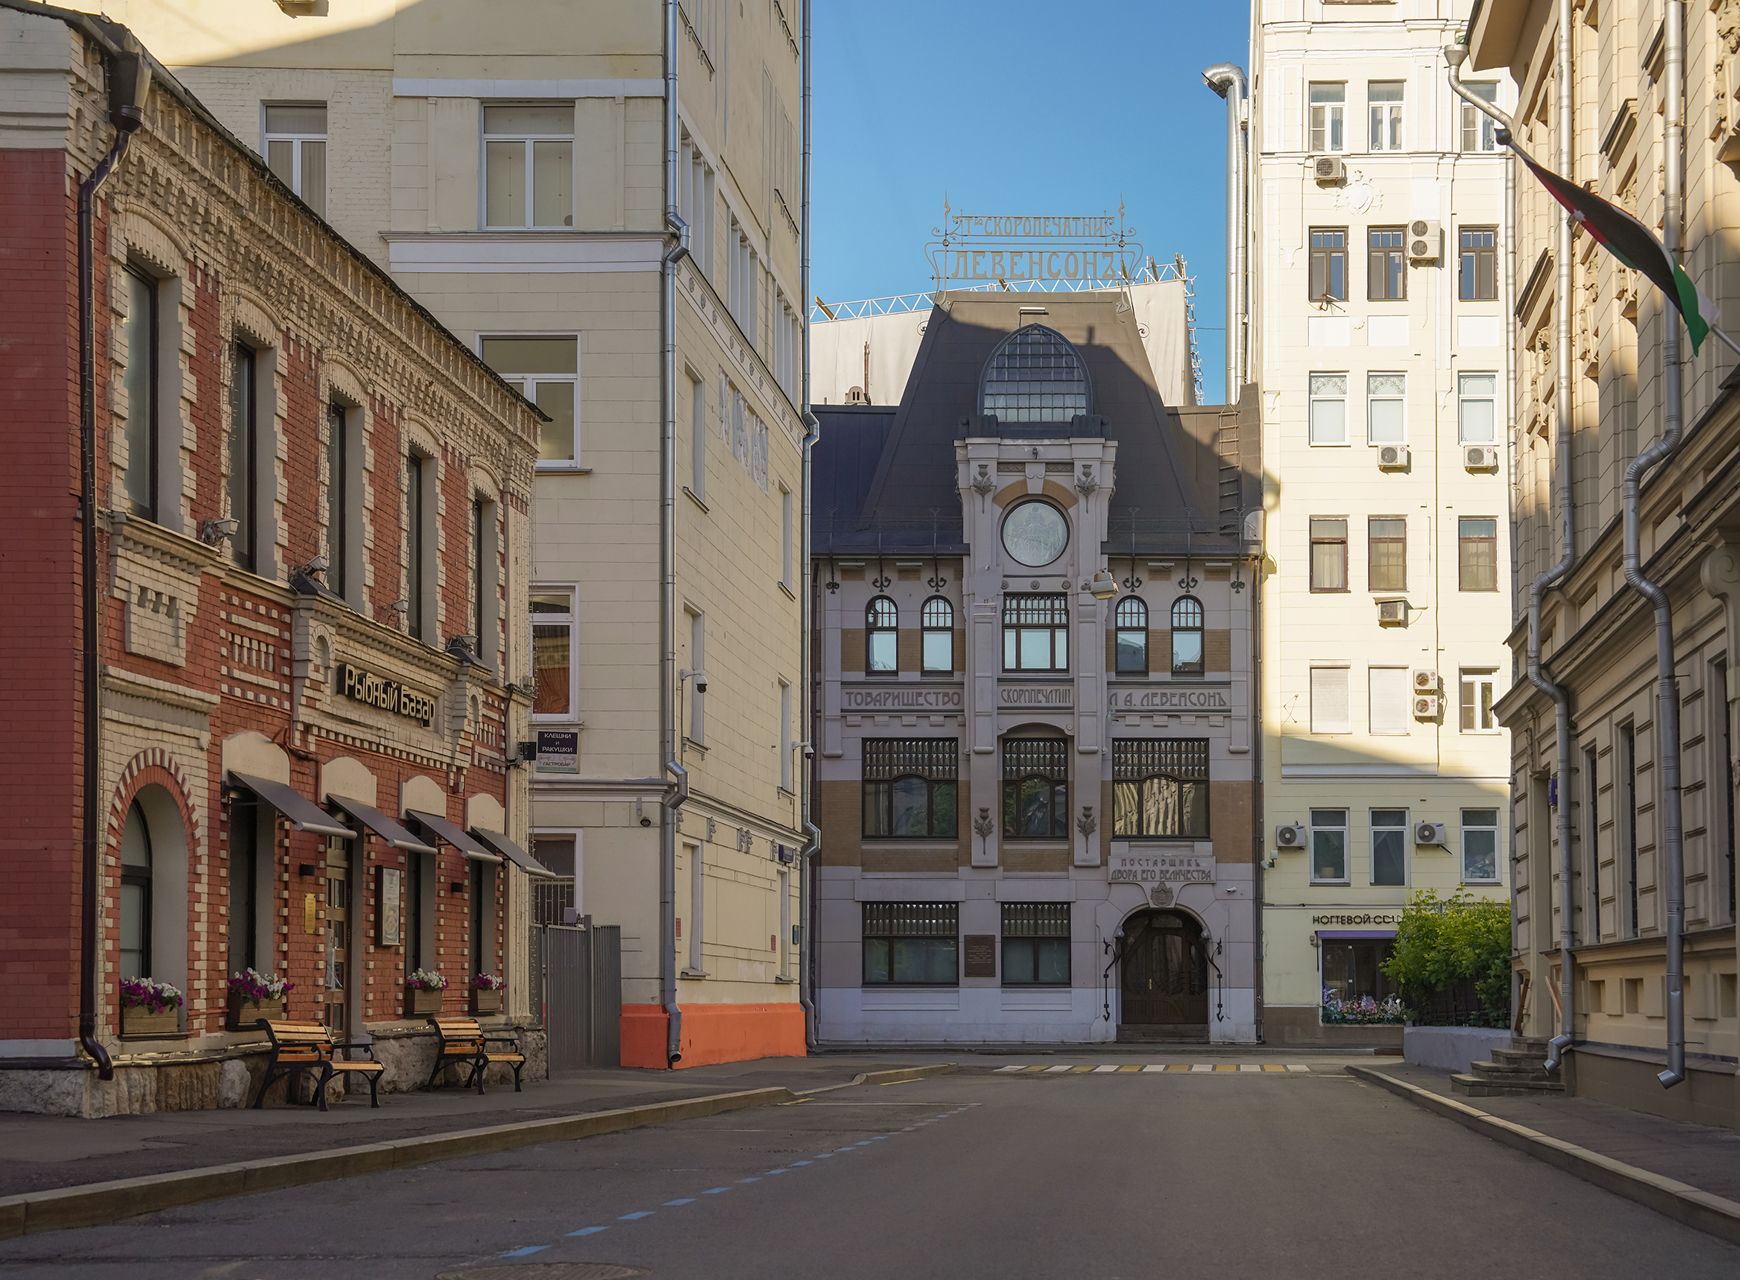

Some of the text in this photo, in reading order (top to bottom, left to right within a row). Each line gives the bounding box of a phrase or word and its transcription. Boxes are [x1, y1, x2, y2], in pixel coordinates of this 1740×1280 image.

[951, 251, 1117, 279] ЛЕВЕНСОНЪ
[345, 663, 436, 725] Рыбный Базар
[845, 691, 961, 706] ТОВАРИЩЕСТВО
[1140, 692, 1227, 706] ЛЕВЕНСОНЪ
[1111, 869, 1212, 880] ДВОРА ЕГО ВЕЛИЧЕСТВА
[1312, 913, 1371, 925] НОГТЕВОЙ
